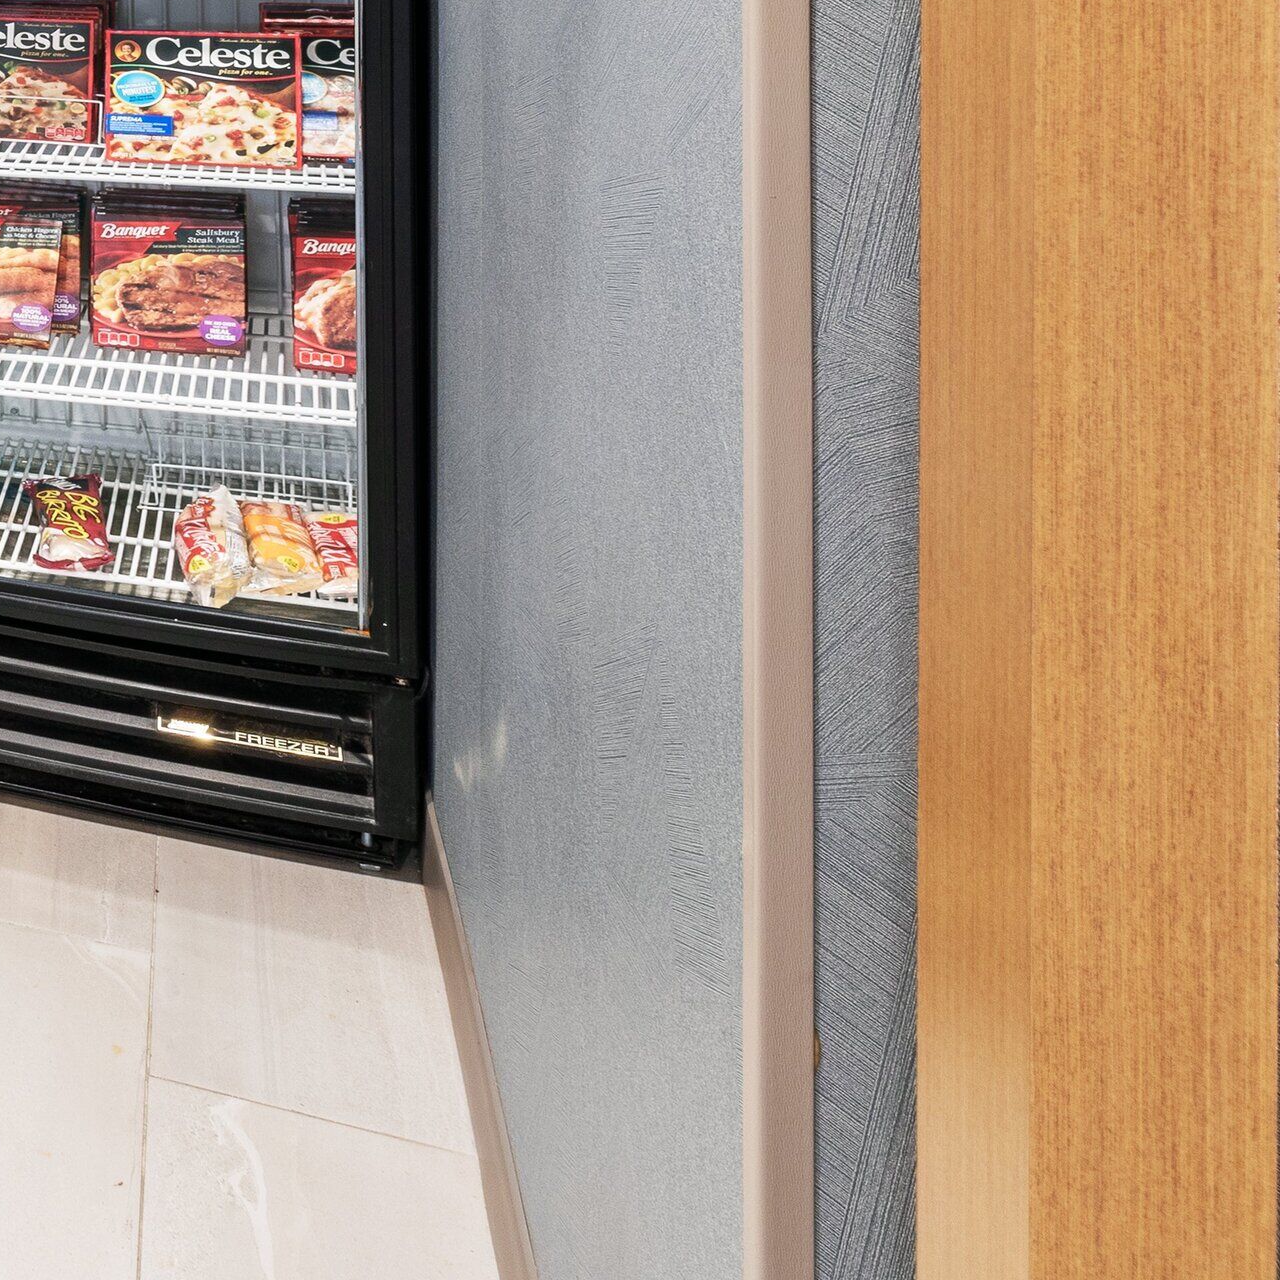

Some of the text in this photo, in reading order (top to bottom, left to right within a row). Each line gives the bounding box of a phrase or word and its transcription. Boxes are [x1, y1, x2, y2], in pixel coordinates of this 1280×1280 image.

[21, 50, 40, 58] pizza
[40, 50, 51, 58] for
[146, 36, 288, 69] Celeste
[218, 68, 240, 76] pizza
[102, 222, 170, 239] Banquet
[195, 229, 240, 238] Salisbury
[187, 236, 240, 244] Steak Meal
[302, 238, 356, 256] Banqu
[13, 312, 50, 322] NATURAL
[205, 333, 236, 341] CHEESE
[64, 492, 101, 523] BIG
[36, 490, 90, 539] BURRITO
[235, 732, 330, 756] FREEZER
